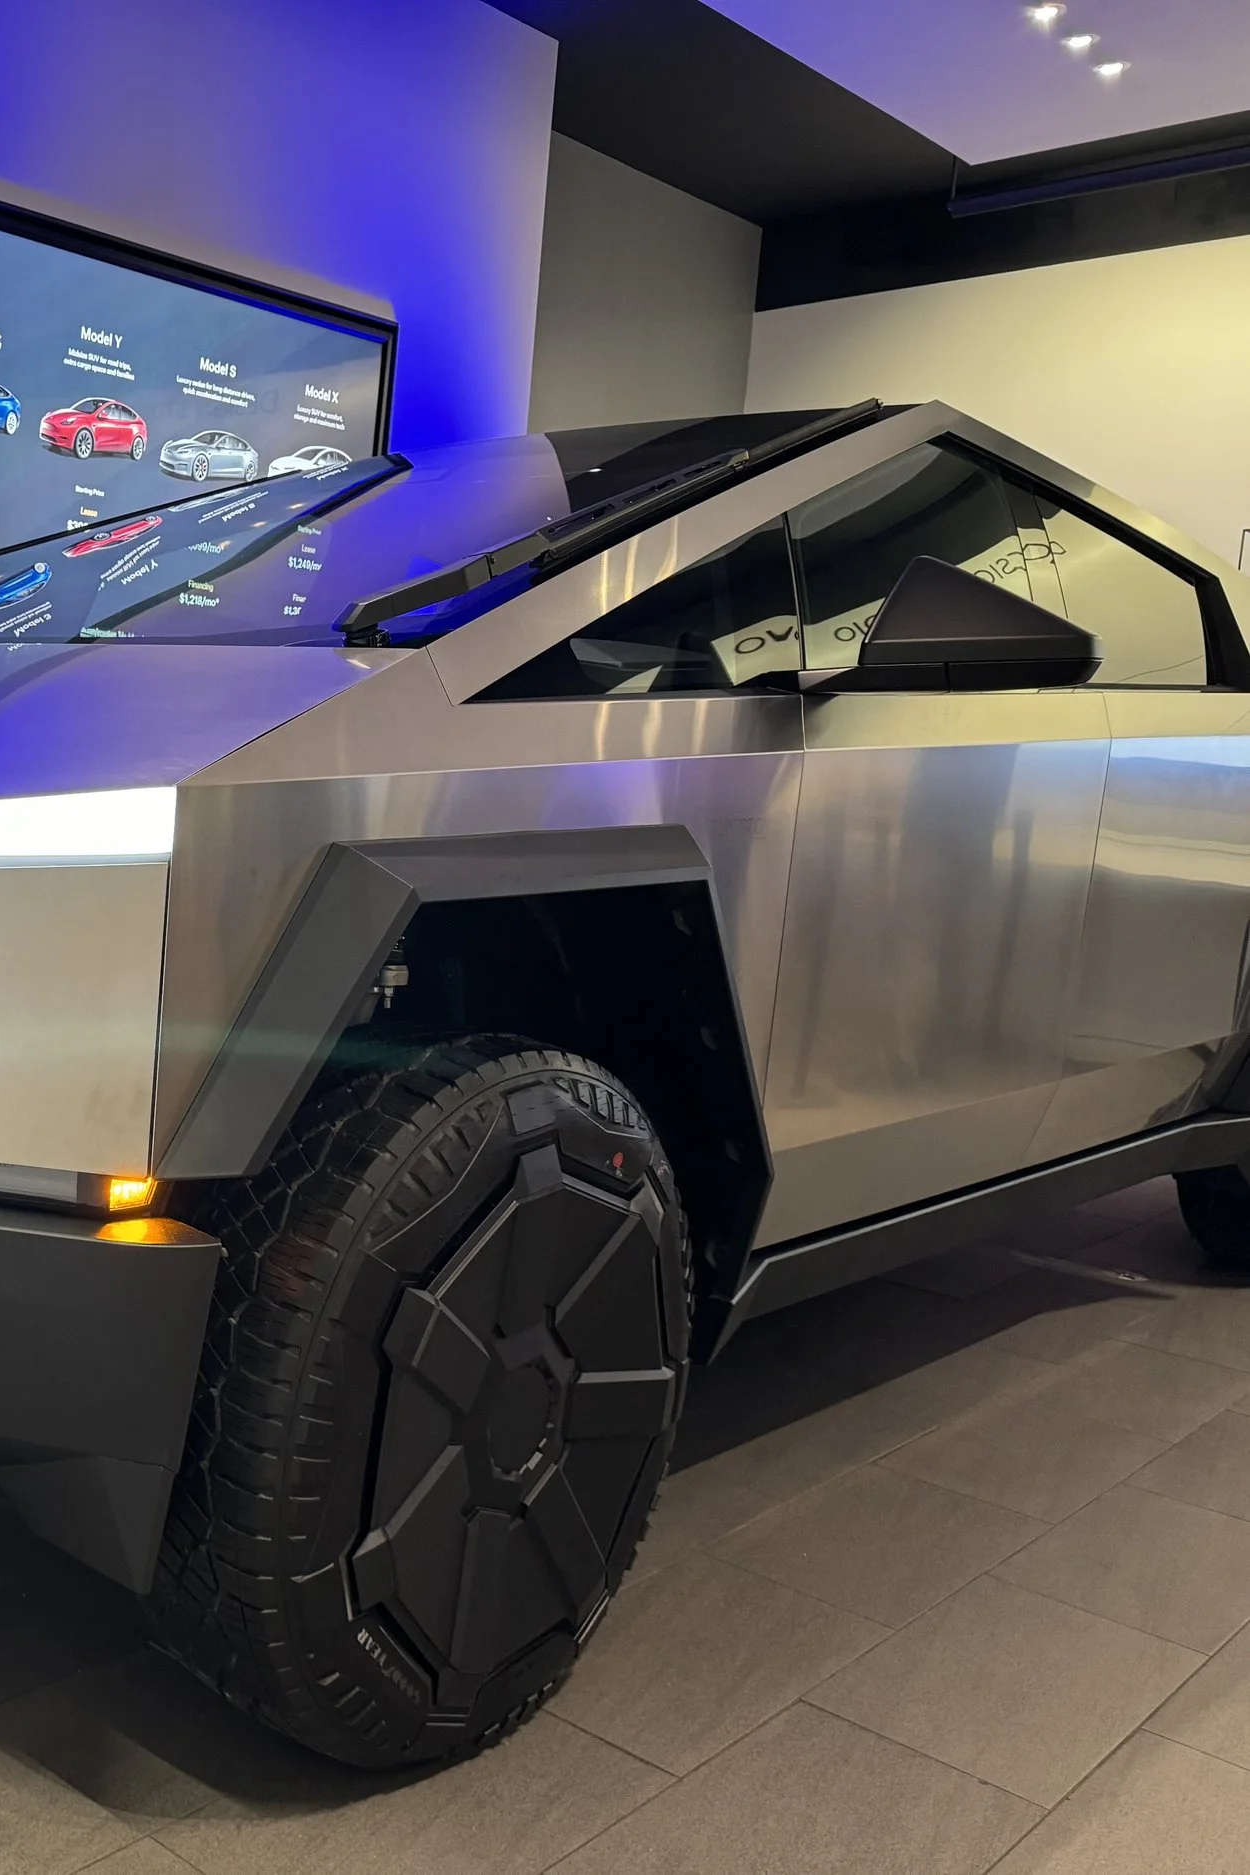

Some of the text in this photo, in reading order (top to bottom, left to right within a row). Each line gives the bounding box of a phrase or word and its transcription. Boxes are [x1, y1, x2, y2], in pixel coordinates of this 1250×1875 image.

[80, 325, 123, 349] Model Y
[88, 353, 100, 363] SUV
[199, 356, 237, 378] Model S
[305, 384, 340, 404] Model X
[80, 506, 98, 518] Lease
[301, 544, 316, 554] Lease
[188, 579, 214, 593] Financing
